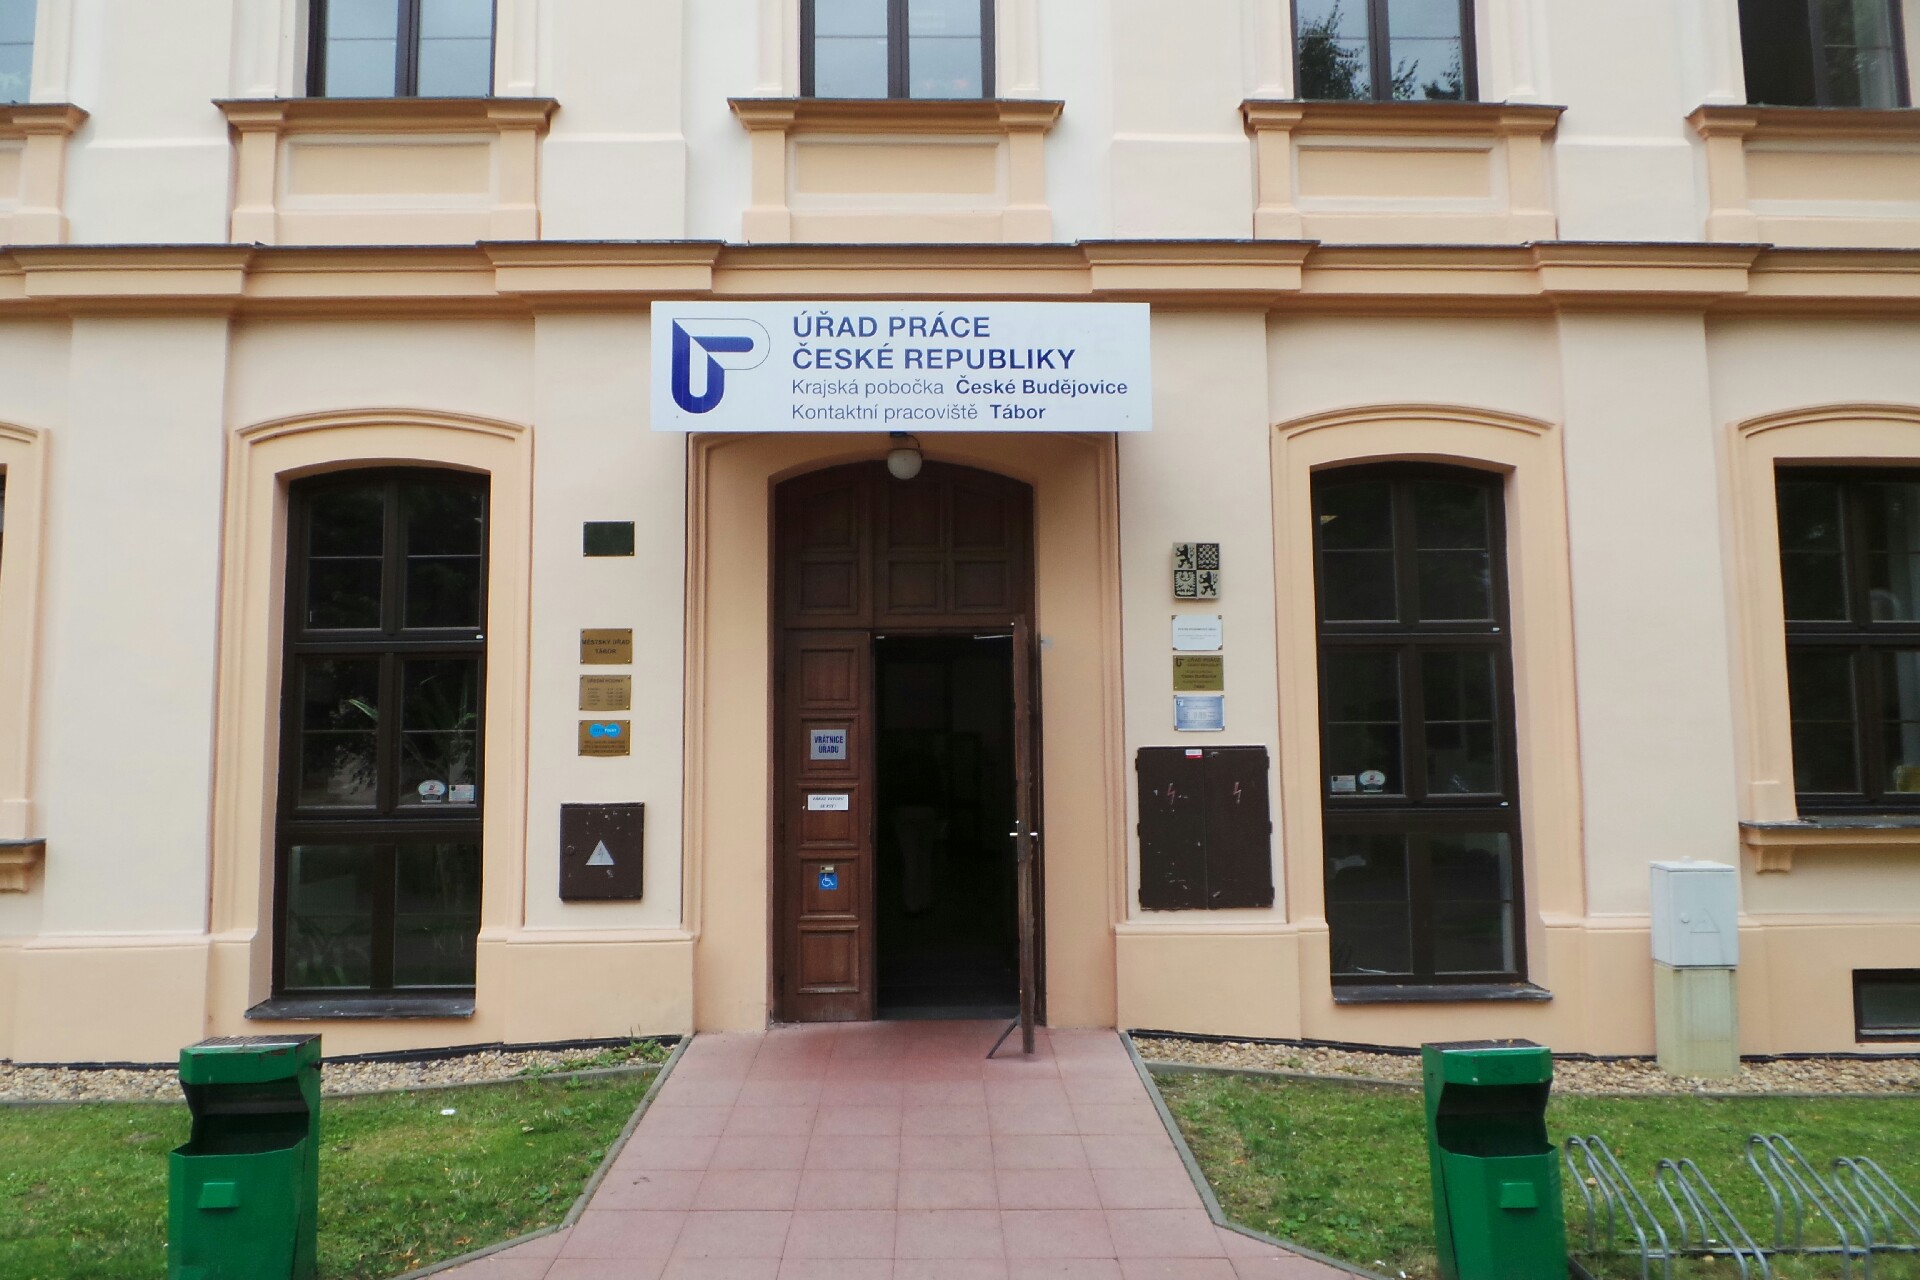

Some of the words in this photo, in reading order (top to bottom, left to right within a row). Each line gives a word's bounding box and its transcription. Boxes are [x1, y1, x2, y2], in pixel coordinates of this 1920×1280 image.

[793, 310, 878, 338] ÚŘAD
[889, 310, 990, 338] PRÁCE
[792, 342, 894, 370] ČESKÉ
[904, 348, 1076, 370] REPUBLIKY
[792, 379, 858, 398] Krajská
[866, 379, 944, 398] pobočka
[956, 375, 1016, 394] České
[1023, 379, 1128, 397] Budějovice
[792, 403, 878, 419] Kontaktní
[884, 403, 978, 423] pracoviště
[990, 403, 1046, 419] Tábor
[814, 734, 843, 743] VRÁTNICE
[818, 744, 839, 753] ÚŘADU
